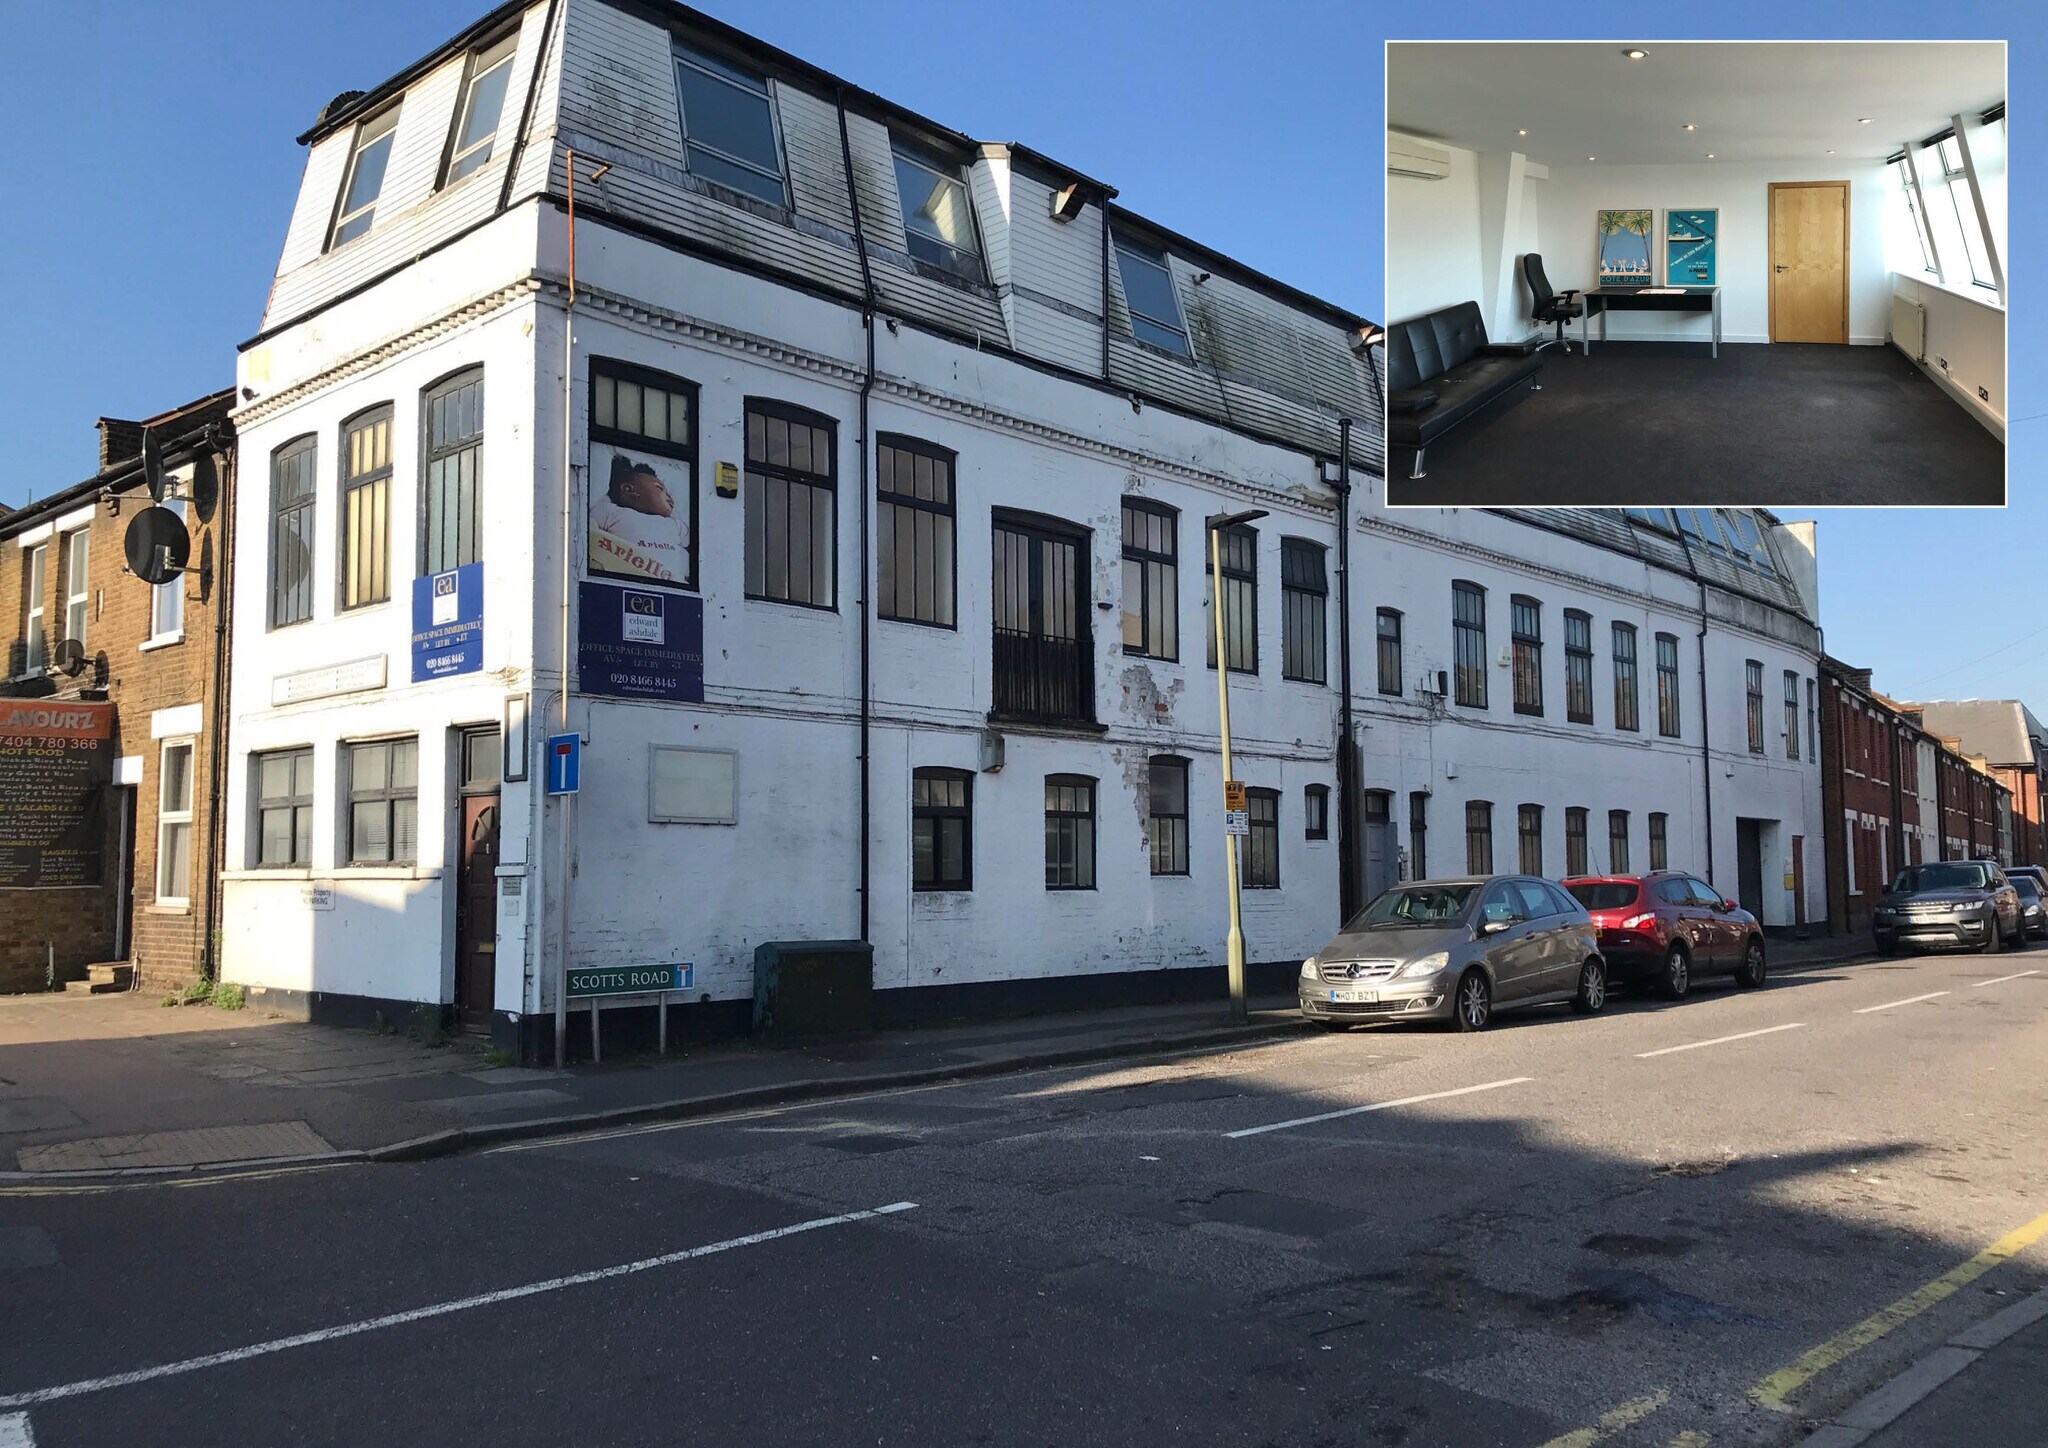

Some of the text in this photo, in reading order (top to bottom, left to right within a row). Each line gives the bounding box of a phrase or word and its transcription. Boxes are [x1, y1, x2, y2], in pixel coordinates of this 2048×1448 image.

[597, 537, 674, 580] Arielle
[436, 577, 453, 595] ea
[630, 595, 656, 614] ea
[629, 616, 658, 628] edward
[629, 628, 658, 639] ashdale
[581, 643, 701, 662] OFFICE SPACE IMMEDIATELY
[426, 659, 437, 669] 020
[610, 673, 677, 688] 020 8466 8445
[38, 737, 66, 748] 780
[70, 739, 98, 749] 366
[27, 748, 64, 756] FOOD
[572, 971, 670, 989] SCOTTS ROAD
[1357, 991, 1375, 1001] BZT
